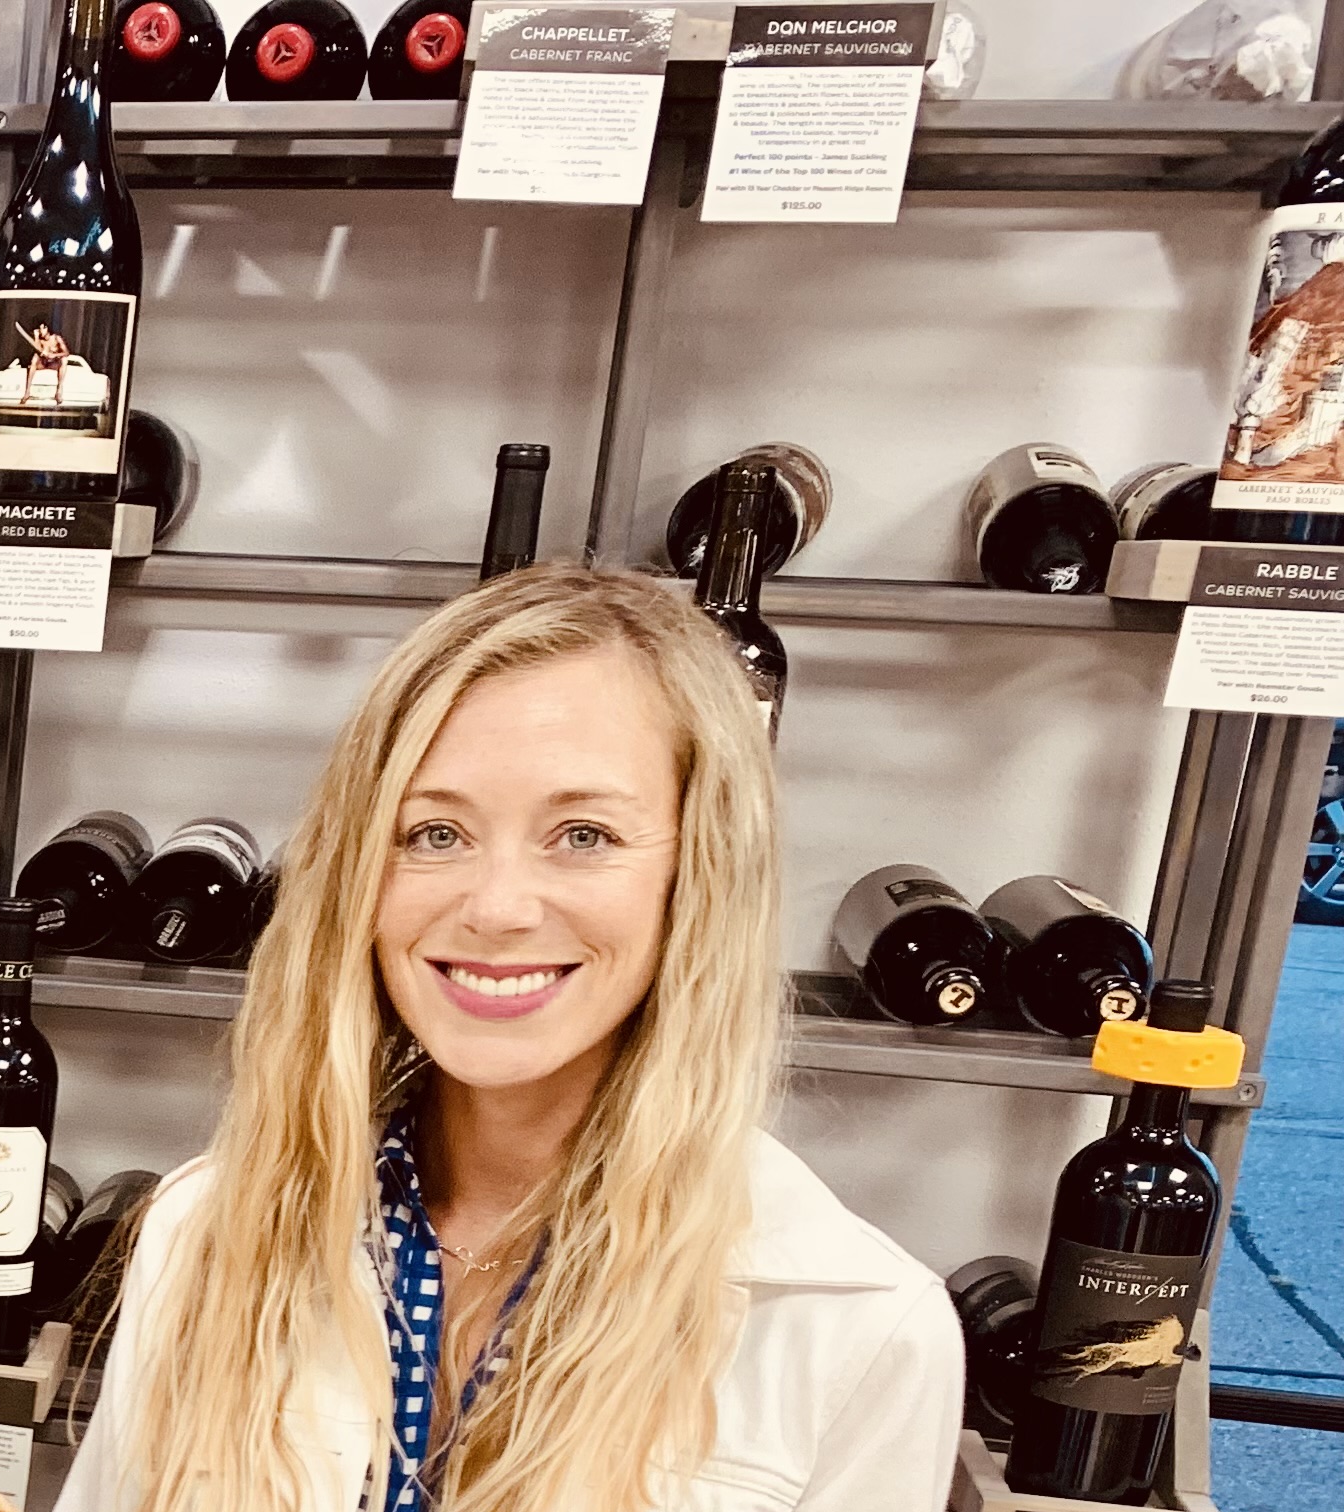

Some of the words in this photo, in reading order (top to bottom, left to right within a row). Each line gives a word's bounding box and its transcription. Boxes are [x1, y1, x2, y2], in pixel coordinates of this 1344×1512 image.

[522, 27, 630, 42] CHAPPELLET
[767, 21, 807, 35] DON
[812, 19, 897, 34] MELCHOR
[510, 49, 583, 61] CABERNET
[586, 50, 633, 62] FRANC
[824, 43, 913, 55] SAUVIGNON
[781, 201, 822, 210] $125.00
[1, 526, 26, 537] RED
[28, 527, 68, 538] BLEND
[1256, 563, 1339, 580] RABBLE
[1205, 584, 1285, 599] CABERNET
[1078, 1274, 1189, 1298] INTERCEPT
